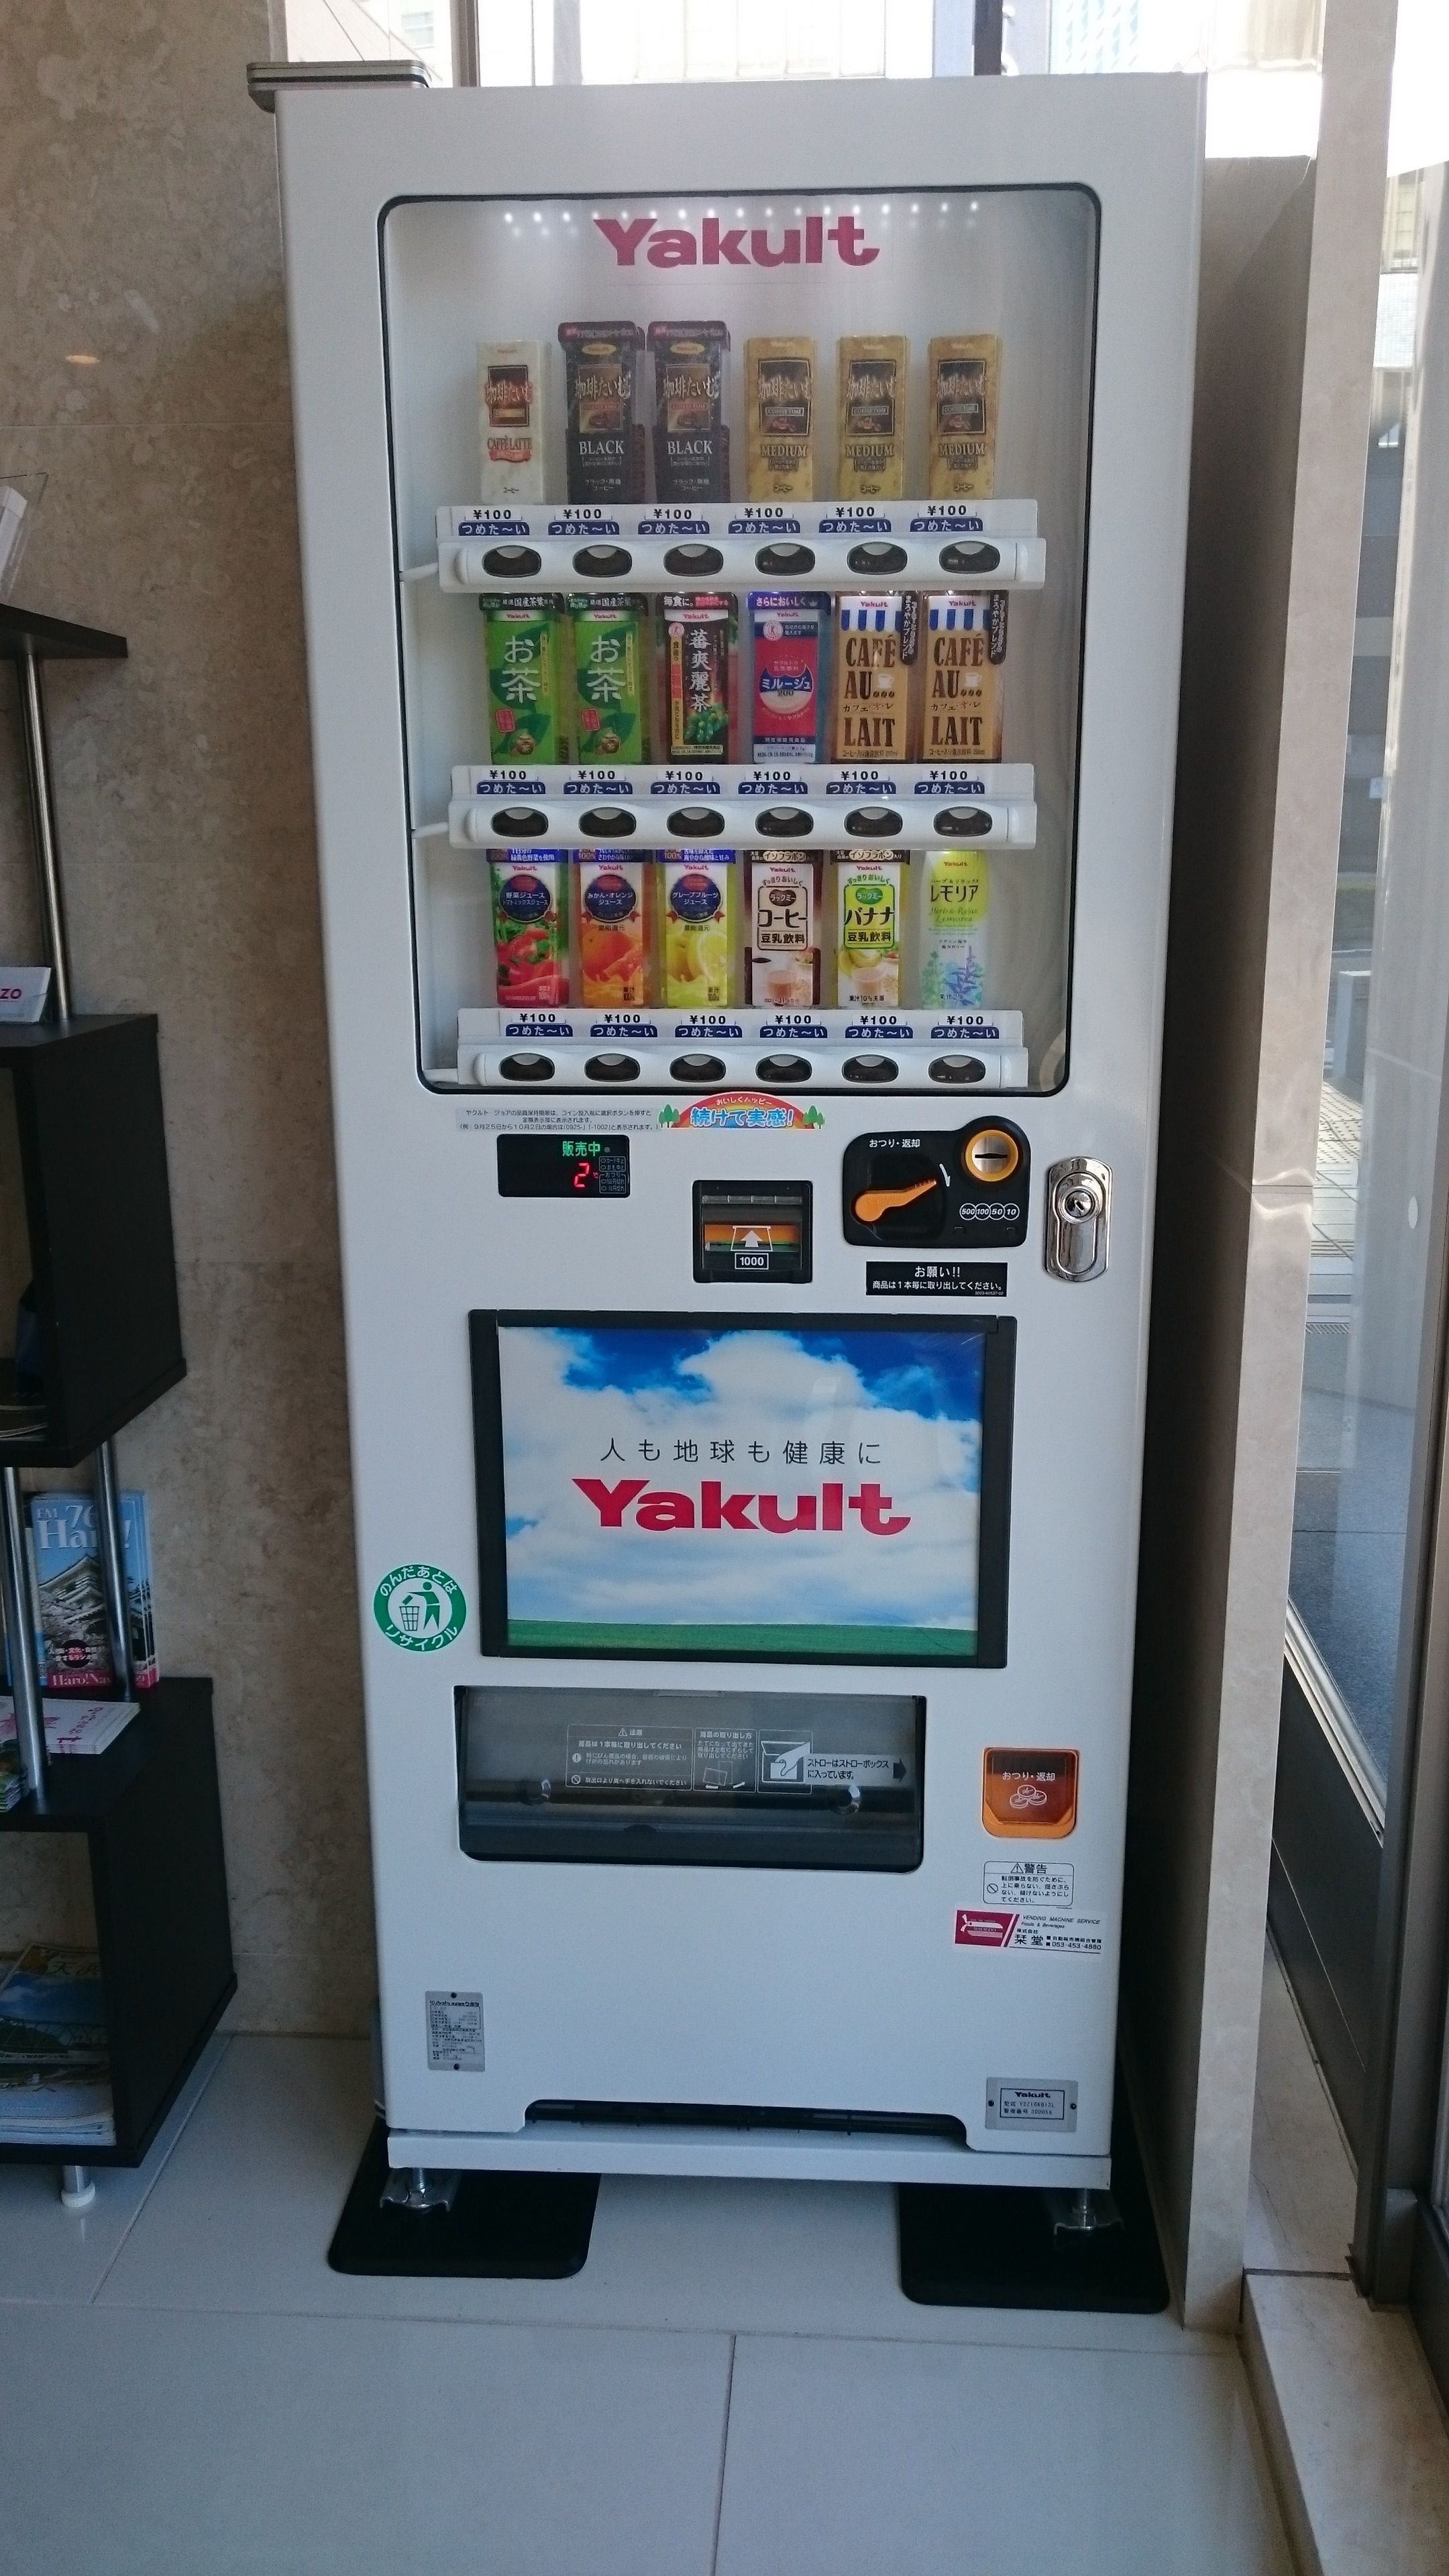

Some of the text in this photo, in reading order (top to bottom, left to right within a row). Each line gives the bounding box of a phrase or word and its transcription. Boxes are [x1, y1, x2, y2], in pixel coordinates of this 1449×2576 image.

[592, 216, 879, 268] Yakult
[508, 437, 532, 449] LATTE
[580, 441, 624, 454] BLACK
[667, 440, 712, 454] BLACK
[761, 445, 807, 457] MEDIUM
[845, 445, 894, 457] MEDIUM
[939, 444, 985, 455] MEDIUM
[473, 509, 511, 519] ¥100
[564, 508, 601, 519] ¥100
[653, 508, 692, 519] ¥100
[745, 508, 783, 518] ¥100
[835, 507, 874, 517] ¥100
[927, 505, 966, 516] ¥100
[663, 596, 694, 606] 毎食に。
[757, 596, 806, 606] さらにおいしく
[902, 596, 912, 659] まろやかブレンド
[991, 594, 999, 656] まろやかブレンド
[846, 635, 896, 667] CAFÉ
[934, 634, 983, 666] CAFÉ
[501, 635, 541, 703] お茶
[587, 635, 625, 702] お茶
[689, 629, 712, 712] 蕃爽麗茶
[762, 678, 811, 690] ミルージュ
[845, 671, 872, 700] AU
[932, 670, 959, 698] AU
[844, 717, 895, 747] LAIT
[931, 716, 982, 745] LAIT
[490, 770, 527, 780] ¥100
[578, 770, 615, 780] ¥100
[665, 771, 703, 781] ¥100
[753, 771, 790, 781] ¥100
[841, 771, 878, 781] ¥100
[930, 770, 967, 780] ¥100
[762, 874, 804, 887] すっきりおいしく
[847, 874, 891, 886] すっきりおいしく
[770, 893, 797, 902] ラックミー
[856, 892, 883, 900] ラックミー
[930, 885, 979, 903] レモリア
[758, 909, 807, 928] コーヒー
[844, 906, 895, 926] バナナ
[761, 933, 805, 944] 豆乳飲料
[847, 932, 892, 942] 豆乳飲料
[520, 1014, 555, 1022] ¥100
[604, 1014, 641, 1024] ¥100
[689, 1015, 726, 1024] ¥100
[775, 1015, 811, 1024] ¥100
[860, 1016, 897, 1025] ¥100
[947, 1016, 983, 1025] ¥100
[716, 1097, 772, 1106] おいしくハッピー
[562, 1141, 600, 1157] 販売中
[869, 1139, 920, 1148] おつり・返却
[574, 1163, 590, 1187] 2
[961, 1208, 1016, 1216] 500 100 50 10
[739, 1256, 764, 1266] 1000
[600, 1437, 881, 1465] 人も地球も健康に
[572, 1478, 911, 1536] Yakult
[380, 1566, 457, 1596] のんだあとは
[385, 1624, 458, 1651] リサイクル
[808, 1758, 889, 1768] ストローはストローボックス
[808, 1771, 854, 1779] に入っています。
[1002, 1772, 1055, 1782] おつり・返却
[1024, 1864, 1047, 1874] 警告
[1052, 1941, 1101, 1950] 053-453-4880
